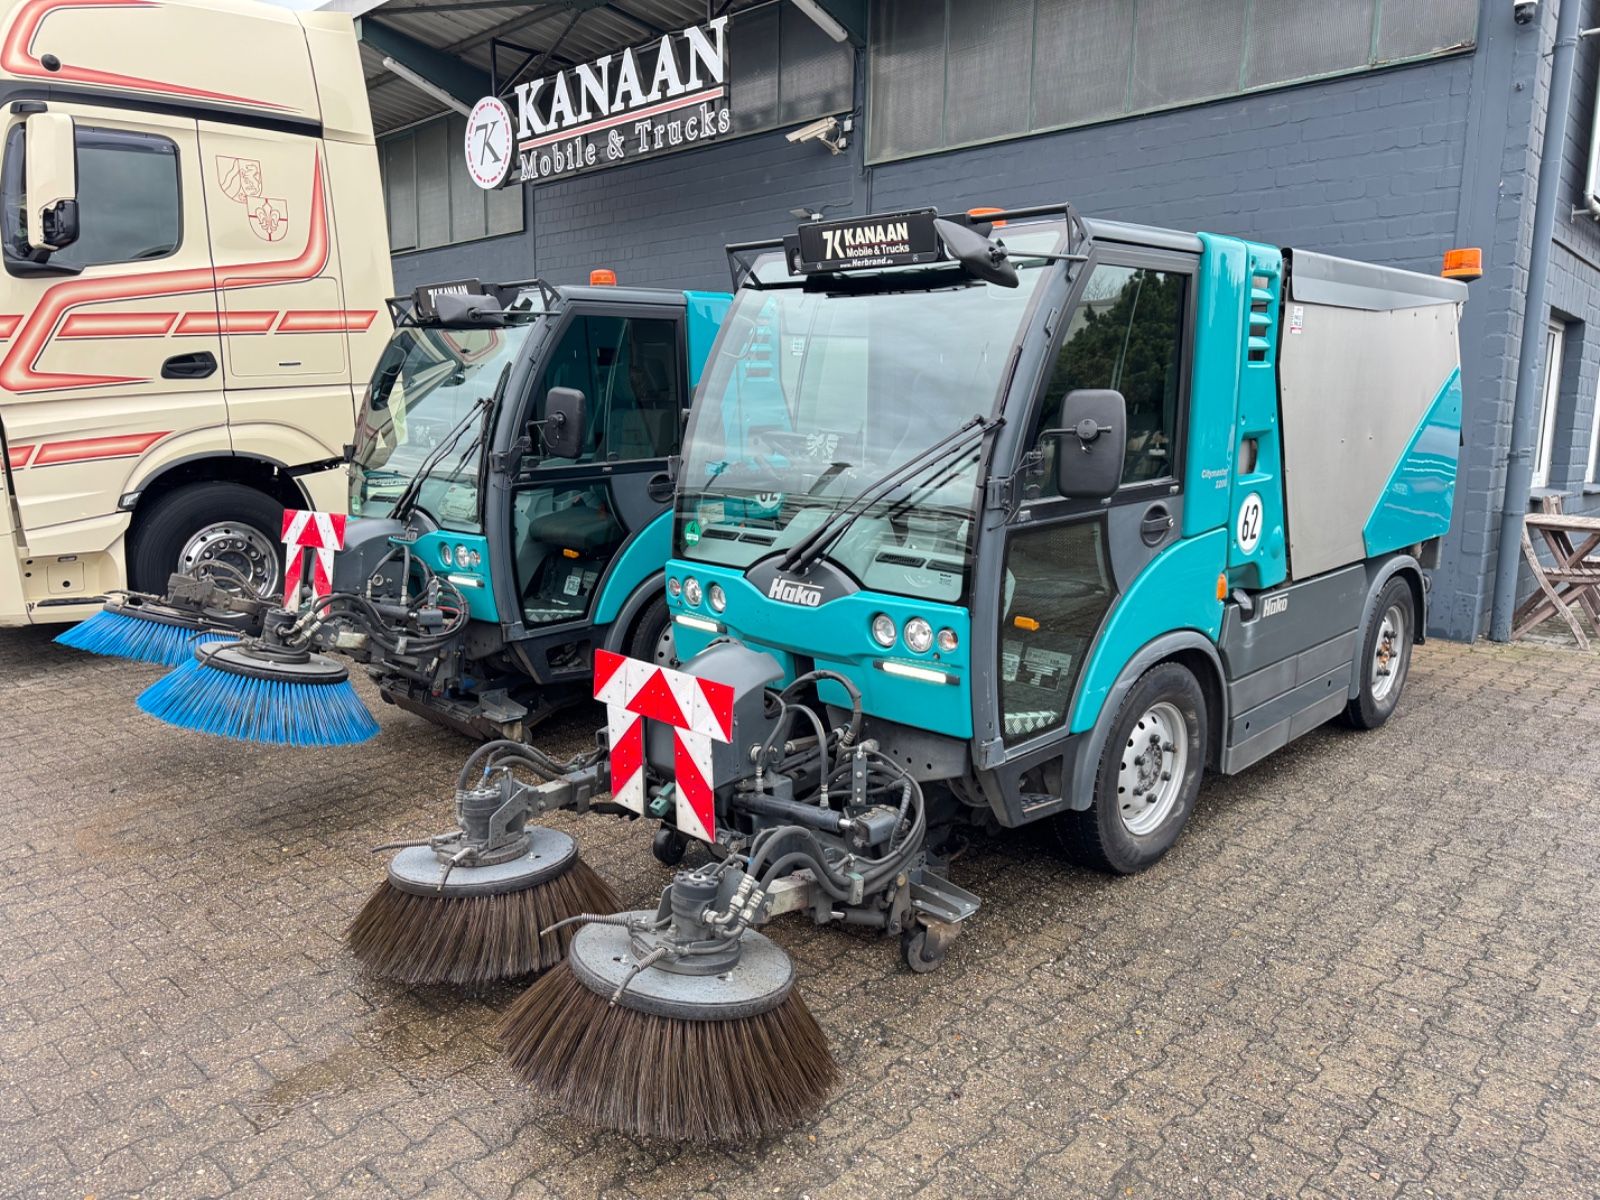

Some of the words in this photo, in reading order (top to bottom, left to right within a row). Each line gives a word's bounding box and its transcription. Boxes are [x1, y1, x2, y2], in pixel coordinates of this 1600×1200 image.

[514, 15, 728, 140] KANAAN
[519, 136, 597, 181] Mobile
[606, 129, 625, 160] &
[634, 103, 731, 153] Trucks
[843, 221, 910, 246] KANAAN
[846, 246, 874, 258] Mobile
[873, 246, 881, 256] &
[880, 242, 910, 254] Trucks
[1241, 503, 1259, 542] 62
[768, 576, 825, 607] Hako
[1262, 594, 1289, 619] Hako
